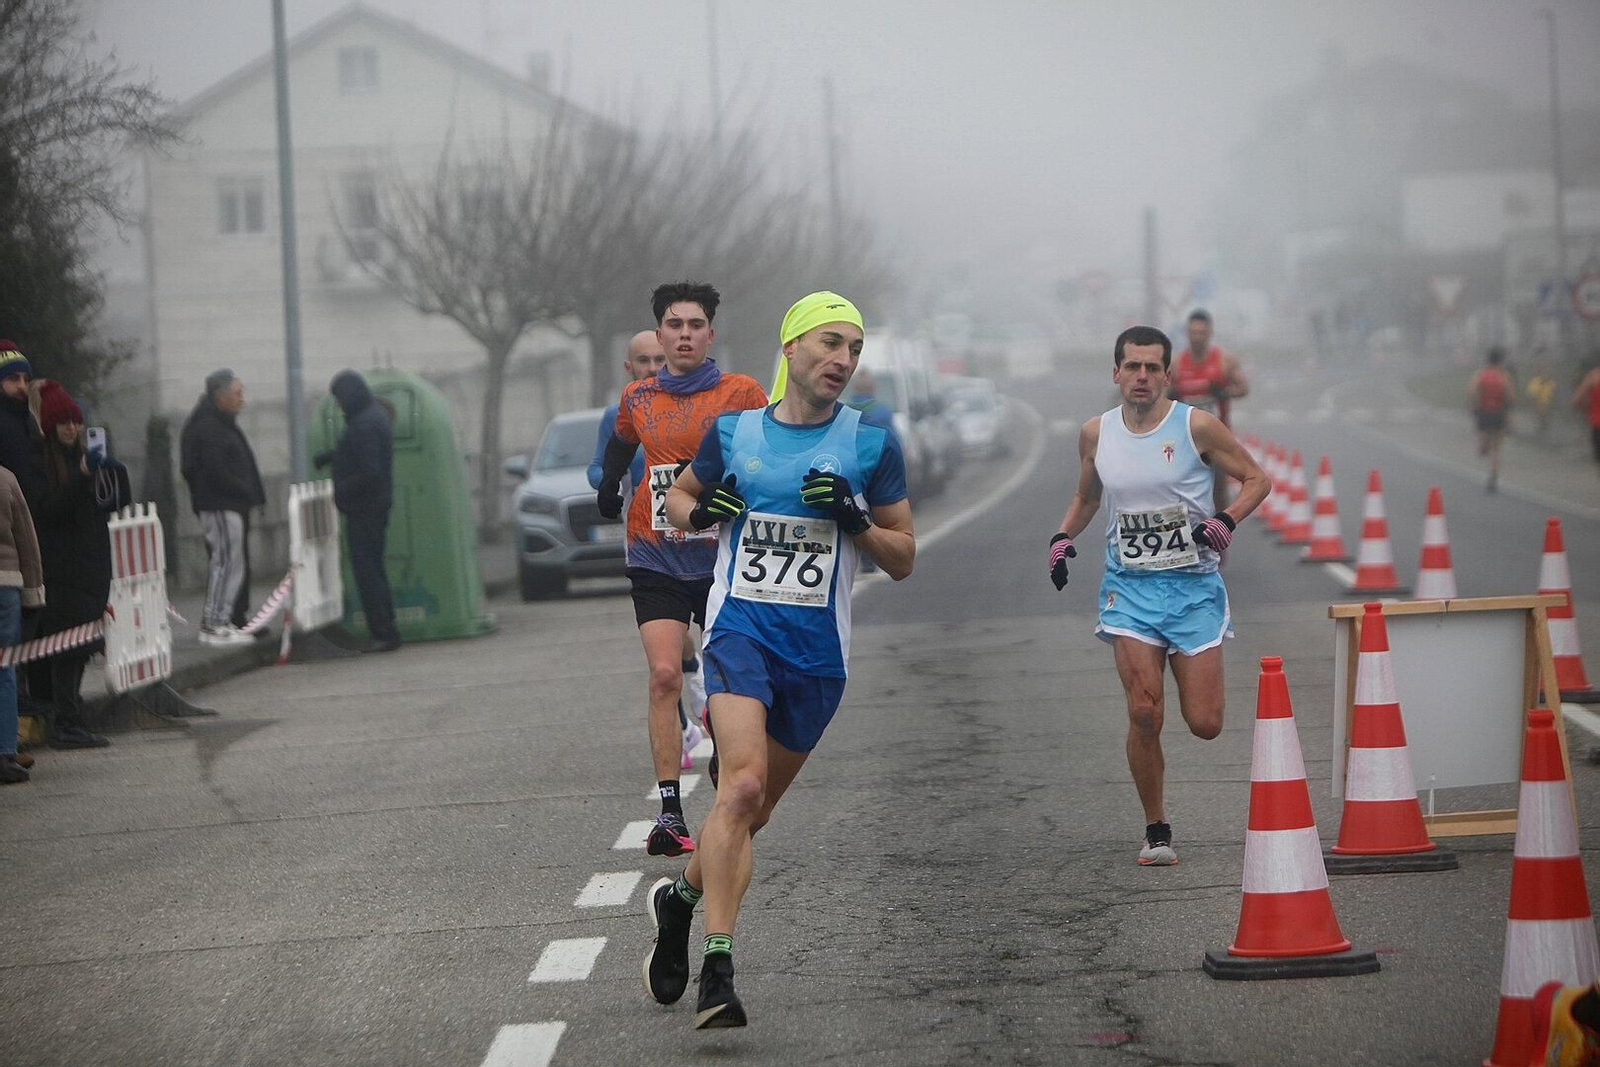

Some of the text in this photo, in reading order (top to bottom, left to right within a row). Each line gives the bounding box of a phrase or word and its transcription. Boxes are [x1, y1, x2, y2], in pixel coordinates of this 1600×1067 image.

[749, 519, 787, 543] XXI
[1121, 528, 1189, 559] 394
[741, 547, 824, 588] 376
